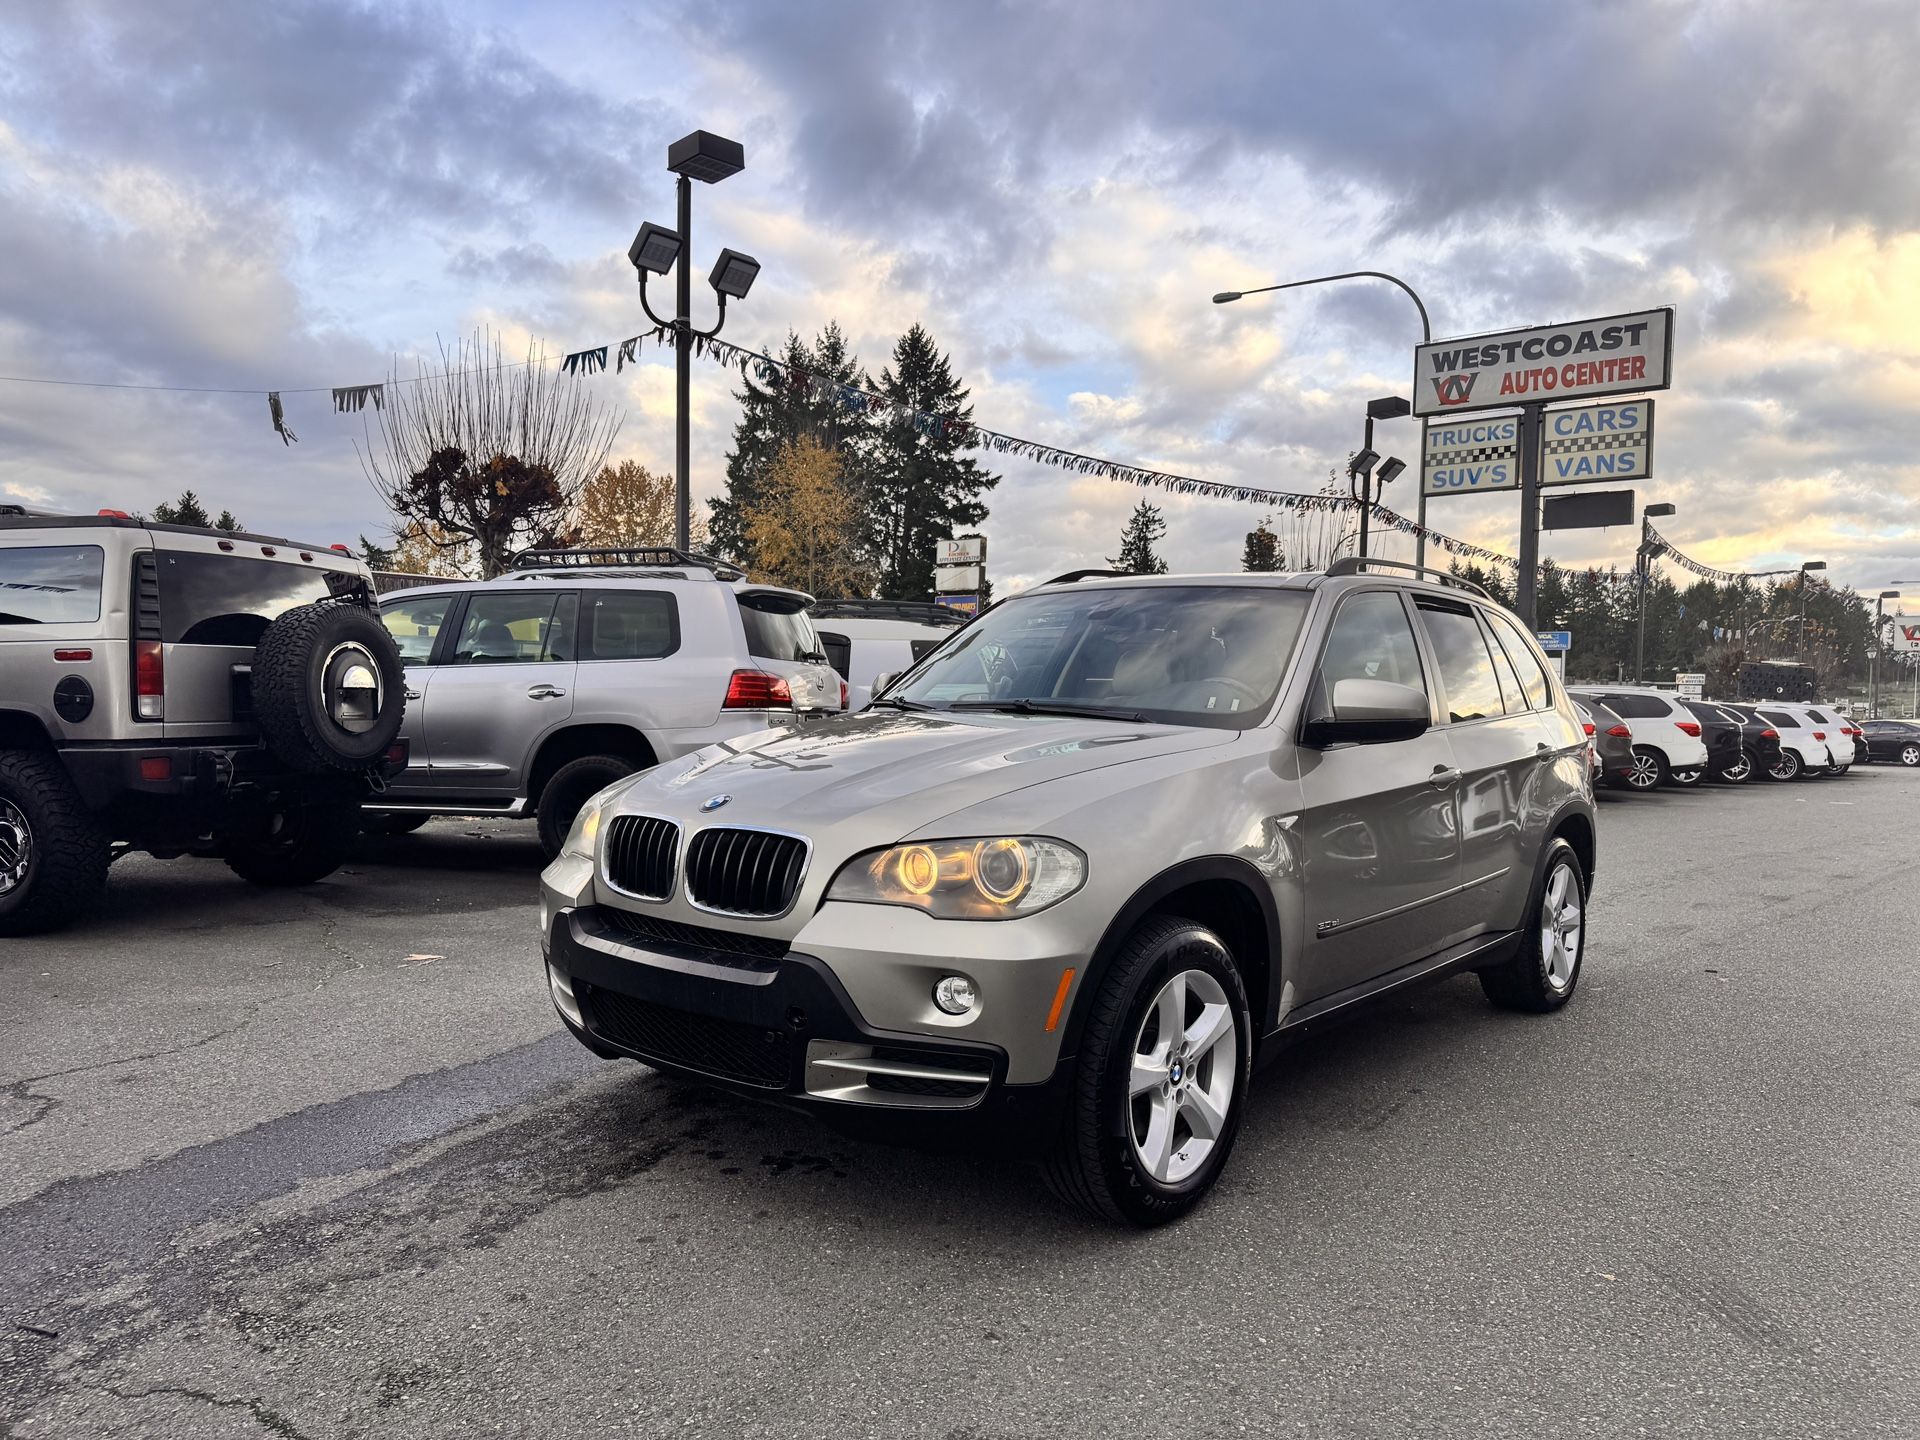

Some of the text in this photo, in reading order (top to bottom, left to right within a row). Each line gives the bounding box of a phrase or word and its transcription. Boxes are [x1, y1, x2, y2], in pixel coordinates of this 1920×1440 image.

[1431, 322, 1648, 373] WESTCOAST
[1500, 355, 1646, 396] AUTO CENTER
[1554, 406, 1638, 436] CARS
[1429, 423, 1515, 448] TRUCKS
[1432, 464, 1507, 489] SUV'S
[1555, 452, 1636, 478] VANS
